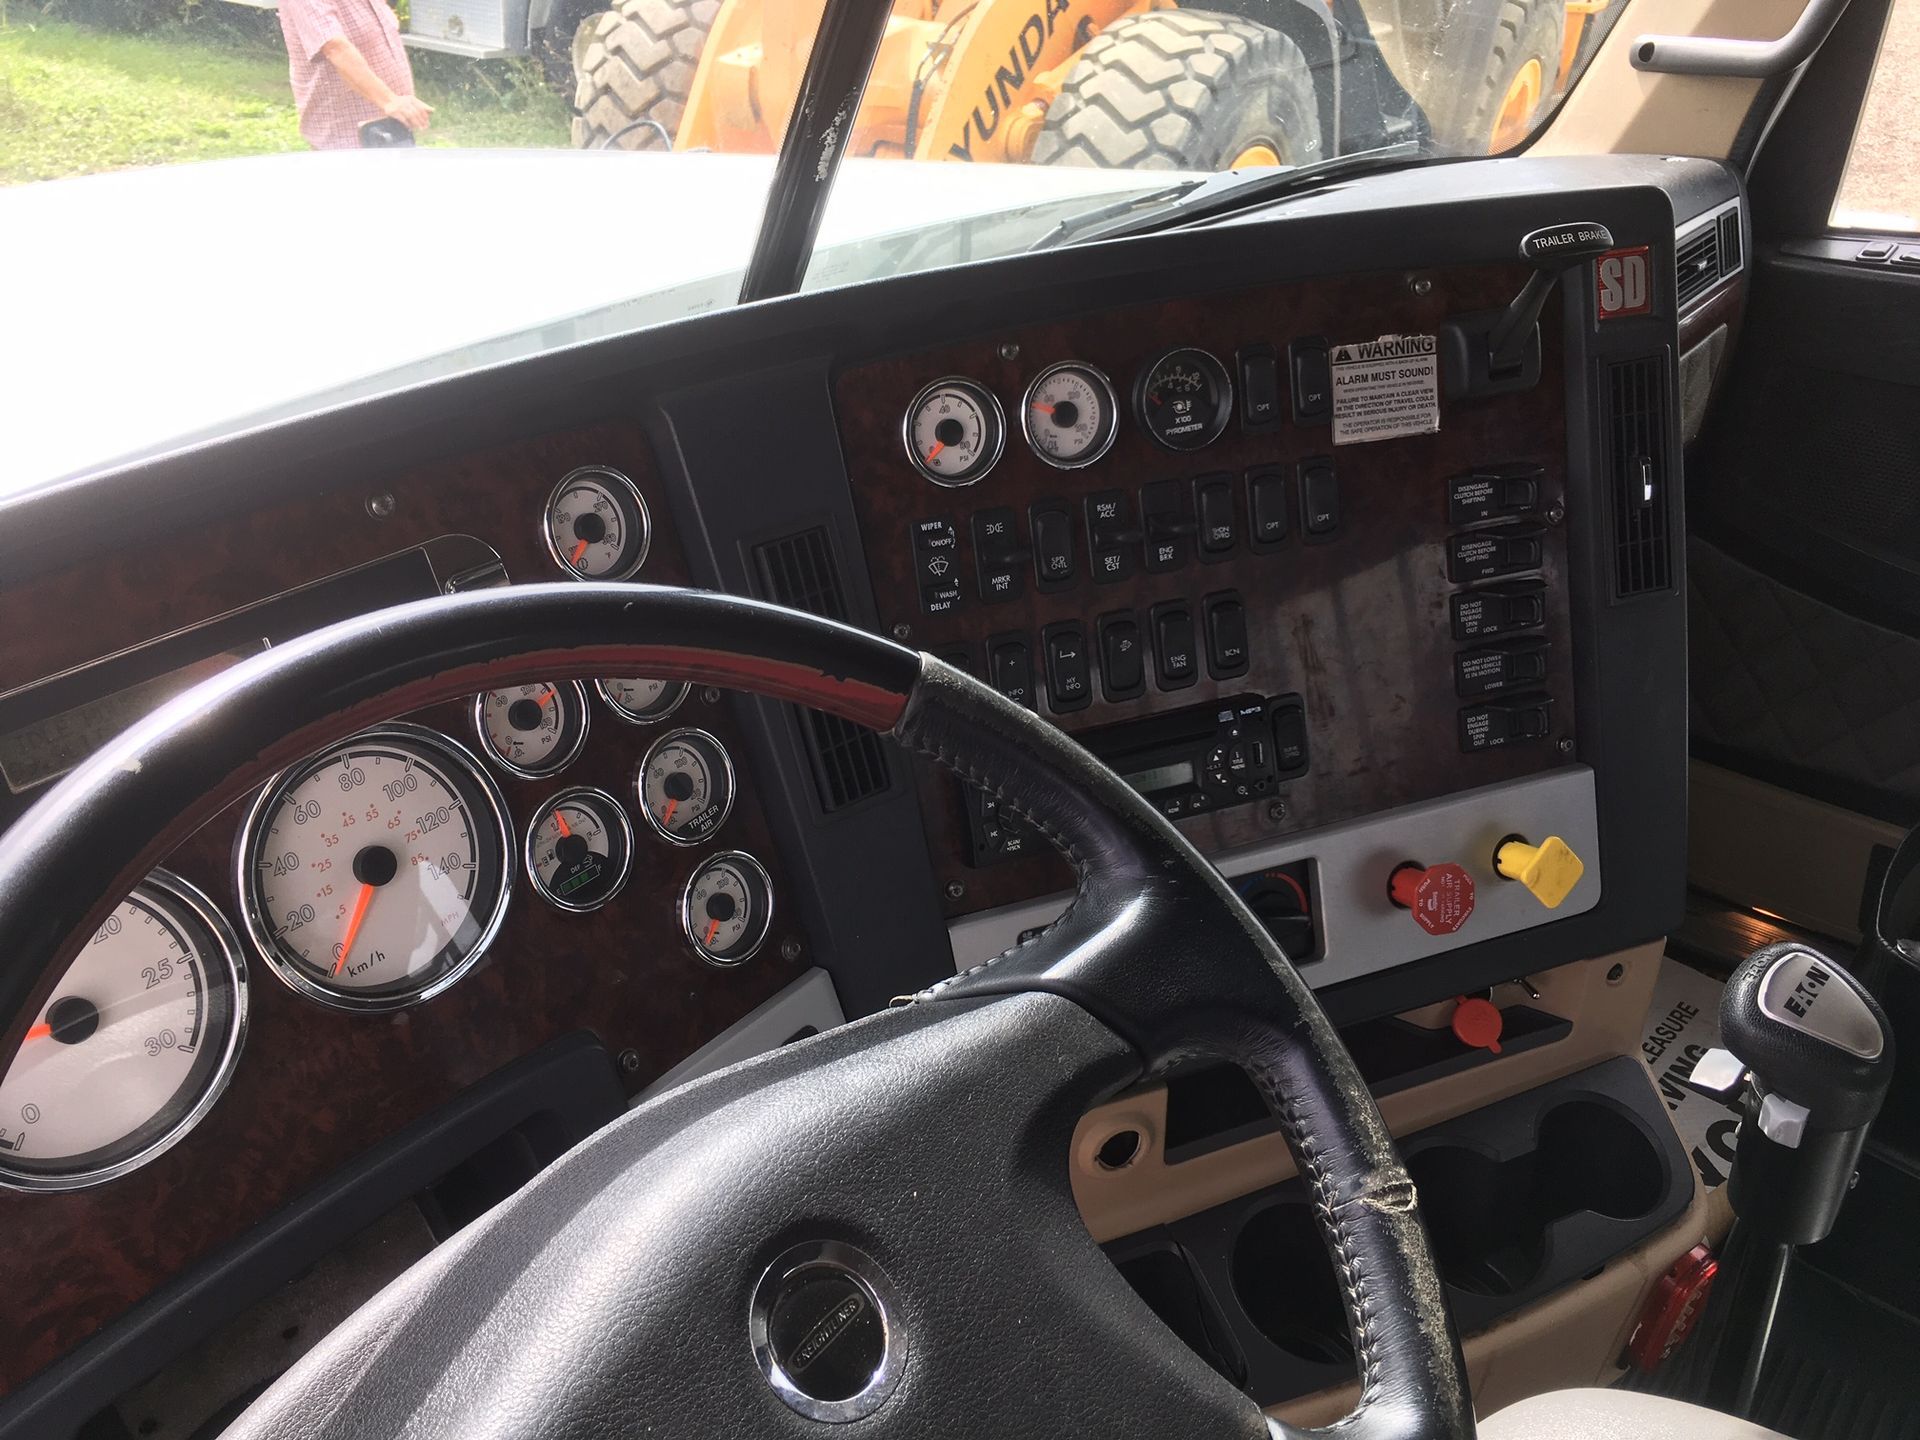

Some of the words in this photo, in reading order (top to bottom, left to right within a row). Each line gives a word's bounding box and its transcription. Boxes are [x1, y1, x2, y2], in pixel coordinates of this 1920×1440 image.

[1532, 233, 1575, 249] TRAILER
[1578, 229, 1609, 242] BRAKE
[1600, 255, 1646, 312] SD
[1357, 337, 1434, 360] WARNING
[1335, 373, 1369, 387] ALARM
[1371, 370, 1397, 382] MUST
[1398, 365, 1434, 380] SOUND!
[1355, 401, 1384, 410] DIRECTION
[1415, 394, 1435, 402] COULD
[1165, 423, 1203, 436] PYROMETER
[1458, 482, 1489, 492] DISENGAGE
[1453, 491, 1474, 500] CLUTCH
[1474, 487, 1493, 497] BEFORE
[1462, 495, 1486, 505] SHIFTING
[1100, 510, 1115, 518] ACC
[1317, 513, 1329, 521] OPT
[921, 521, 943, 532] WIPER
[1266, 521, 1279, 529] OPT
[1461, 541, 1492, 551] DISENGAGE
[1457, 549, 1477, 558] CLUTCH
[1478, 546, 1496, 555] BEFORE
[1104, 556, 1120, 565] SET/
[1465, 554, 1489, 563] SHIFTING
[1106, 562, 1120, 571] CST
[992, 575, 1011, 585] MRKR
[996, 582, 1009, 591] INT
[939, 590, 958, 599] WASH
[930, 601, 951, 612] DELAY
[1470, 601, 1482, 609] NOT
[1460, 608, 1482, 616] ENGAGE
[1460, 614, 1482, 623] DURING
[1465, 620, 1478, 628] SPIN
[1466, 626, 1478, 634] OUT
[1483, 625, 1498, 633] LOCK
[1170, 654, 1187, 662] ENG
[1463, 665, 1480, 673] WHEN
[1481, 661, 1501, 670] VEHICLE
[1479, 667, 1501, 676] MOTION
[648, 682, 659, 692] PSI
[1484, 681, 1503, 690] LOWER
[1477, 713, 1488, 721] NOT
[1467, 720, 1489, 729] ENGAGE
[1468, 726, 1489, 735] DURING
[541, 735, 552, 744] PSI
[1489, 737, 1504, 745] LOCK
[338, 767, 366, 791] 80
[382, 773, 418, 802] 100
[293, 800, 322, 825] 60
[365, 808, 379, 822] 55
[688, 804, 719, 829] TRAILER
[342, 815, 356, 828] 45
[387, 816, 401, 830] 65
[415, 806, 451, 834] 120
[701, 819, 714, 832] AIR
[324, 834, 339, 848] 35
[404, 830, 418, 845] 75
[273, 851, 300, 877] 40
[410, 852, 424, 866] 85
[316, 859, 332, 873] 25
[427, 851, 461, 880] 140
[320, 885, 334, 898] 15
[1418, 898, 1424, 907] TO
[339, 904, 347, 915] 5
[286, 903, 316, 932] 20
[346, 950, 386, 978] km/h
[141, 957, 174, 991] 25
[1783, 961, 1831, 1018] EATON
[144, 1028, 177, 1057] 30
[21, 1102, 41, 1124] 0
